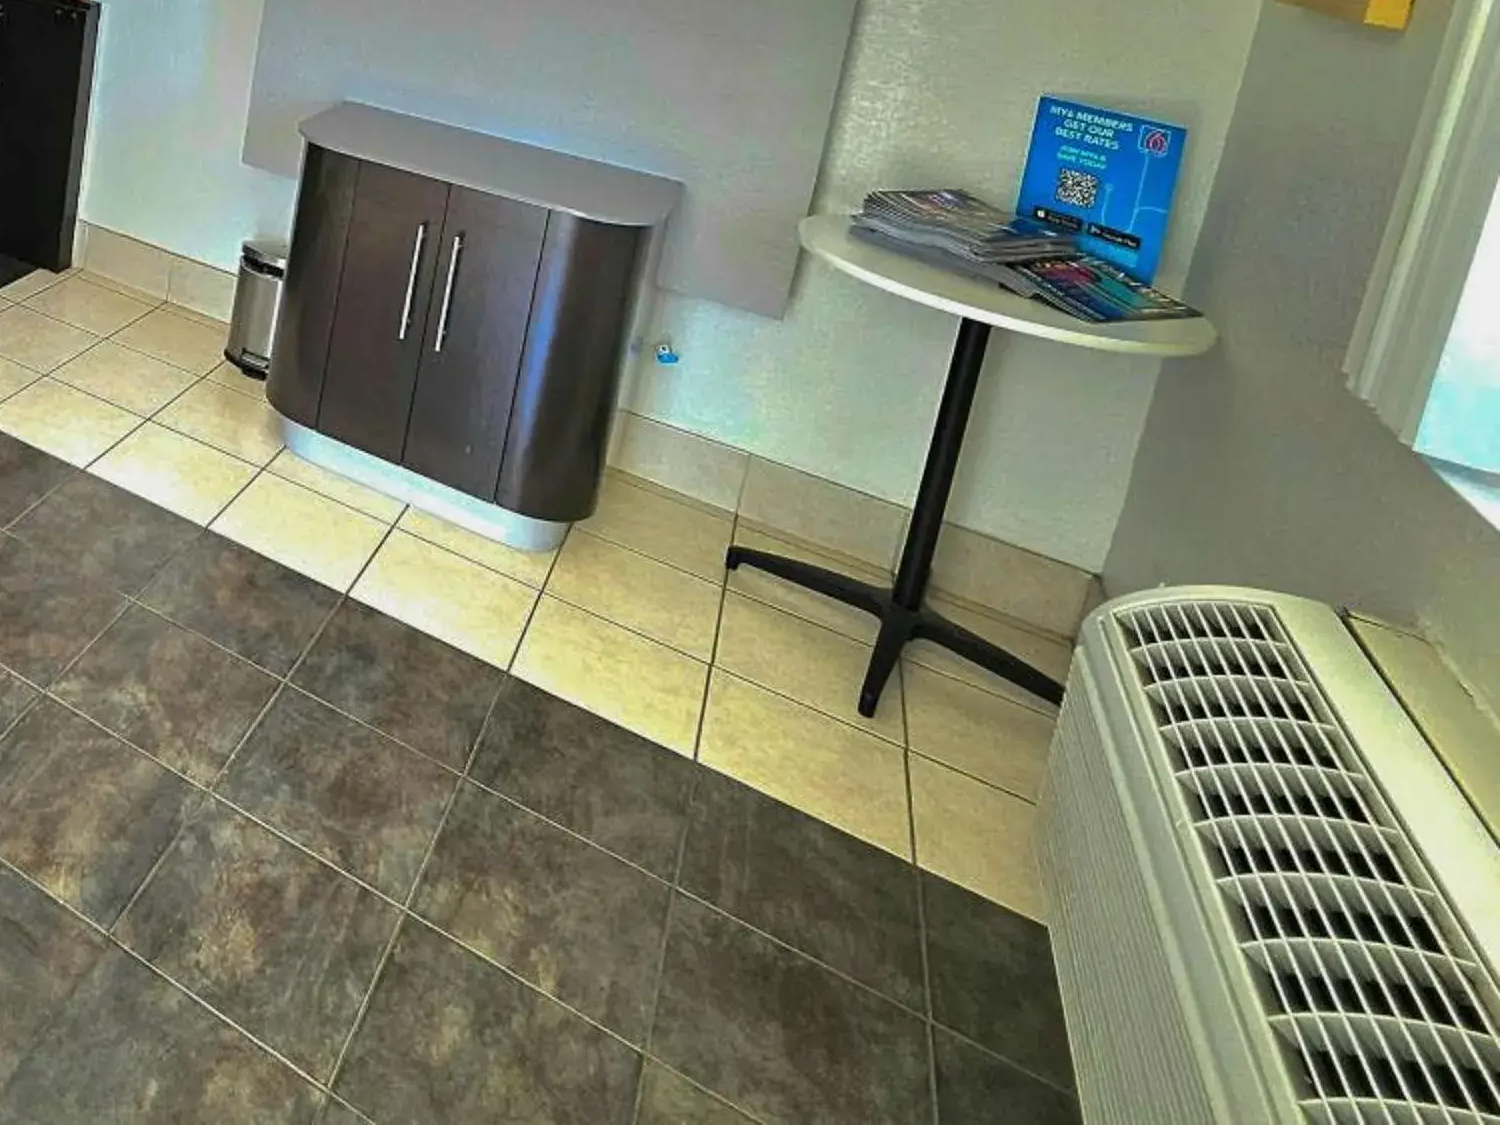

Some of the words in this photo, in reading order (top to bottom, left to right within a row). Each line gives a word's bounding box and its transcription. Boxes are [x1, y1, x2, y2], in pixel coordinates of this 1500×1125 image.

[1064, 118, 1086, 132] GET
[1087, 124, 1115, 138] OUR
[1076, 112, 1133, 132] MEMBERS
[1055, 126, 1082, 140] BEST
[1084, 134, 1119, 150] RATES
